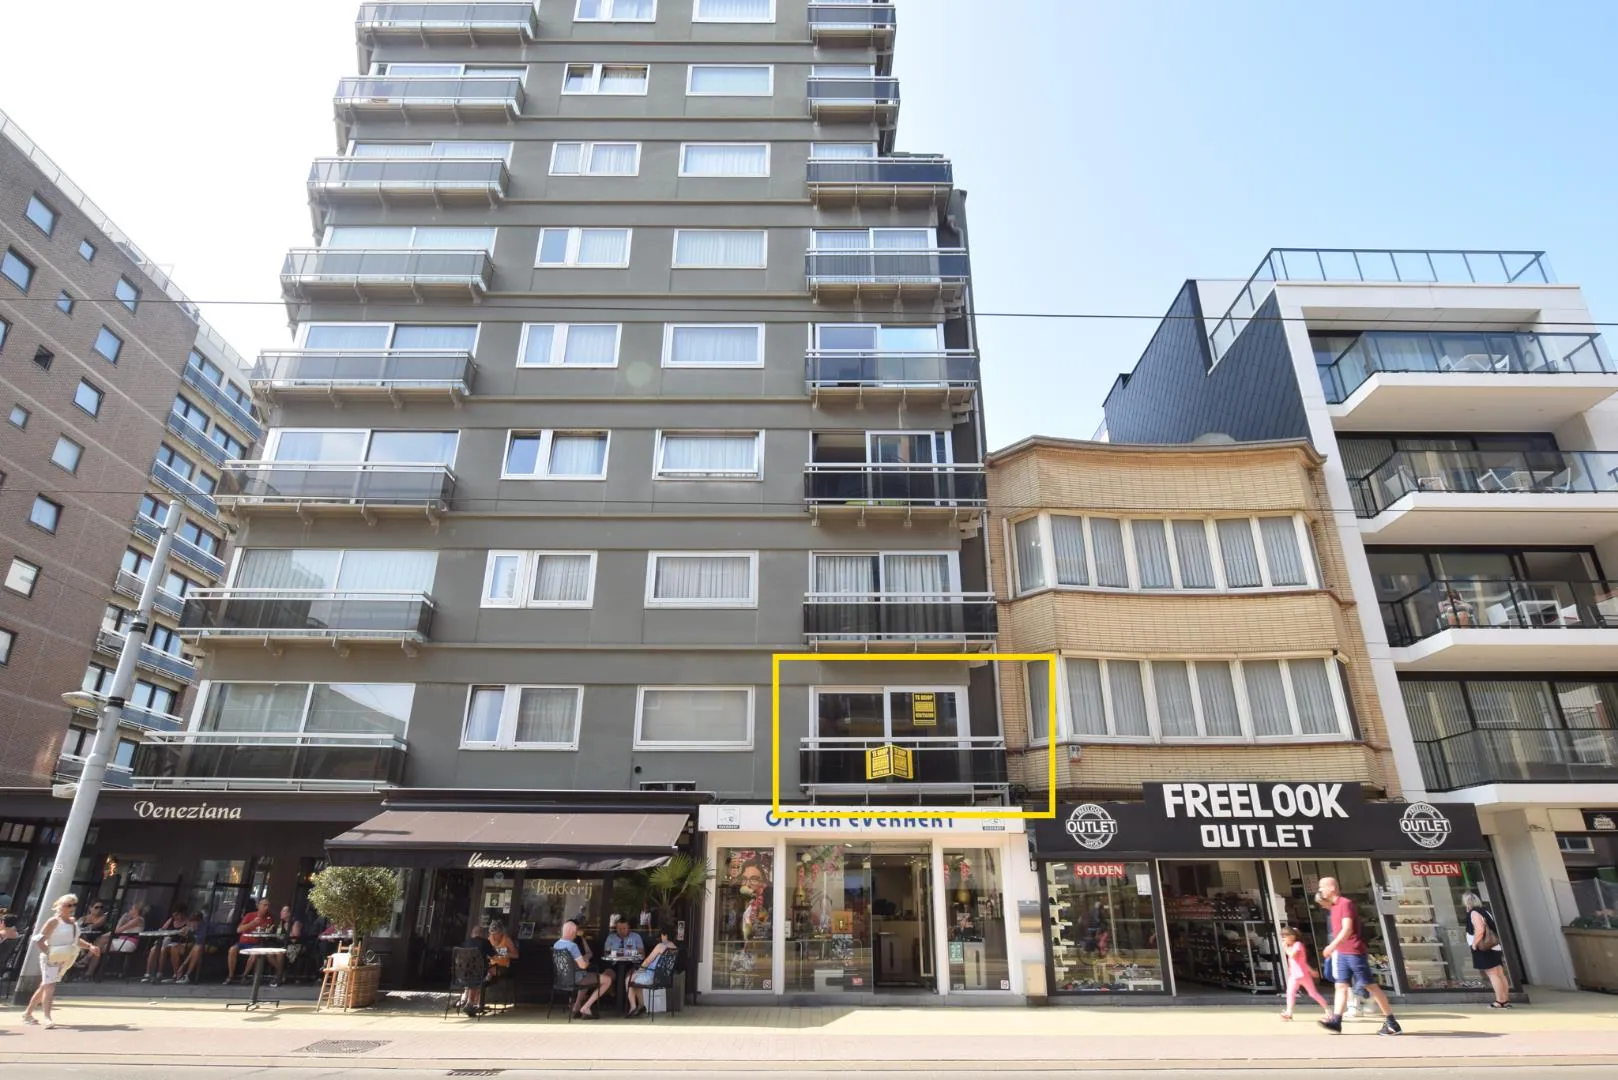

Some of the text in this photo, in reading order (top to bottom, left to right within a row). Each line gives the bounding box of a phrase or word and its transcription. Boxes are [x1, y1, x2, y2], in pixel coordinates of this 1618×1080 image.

[1162, 783, 1350, 818] FREELOOK
[133, 800, 242, 819] Veneziana
[1067, 821, 1117, 833] OUTLET
[1401, 820, 1449, 831] OUTLET
[1200, 824, 1314, 848] OUTLET
[467, 852, 528, 869] Veneziana
[1076, 865, 1123, 876] SOLDEN
[1412, 864, 1459, 875] SOLDEN
[531, 878, 593, 900] Bakkerij
